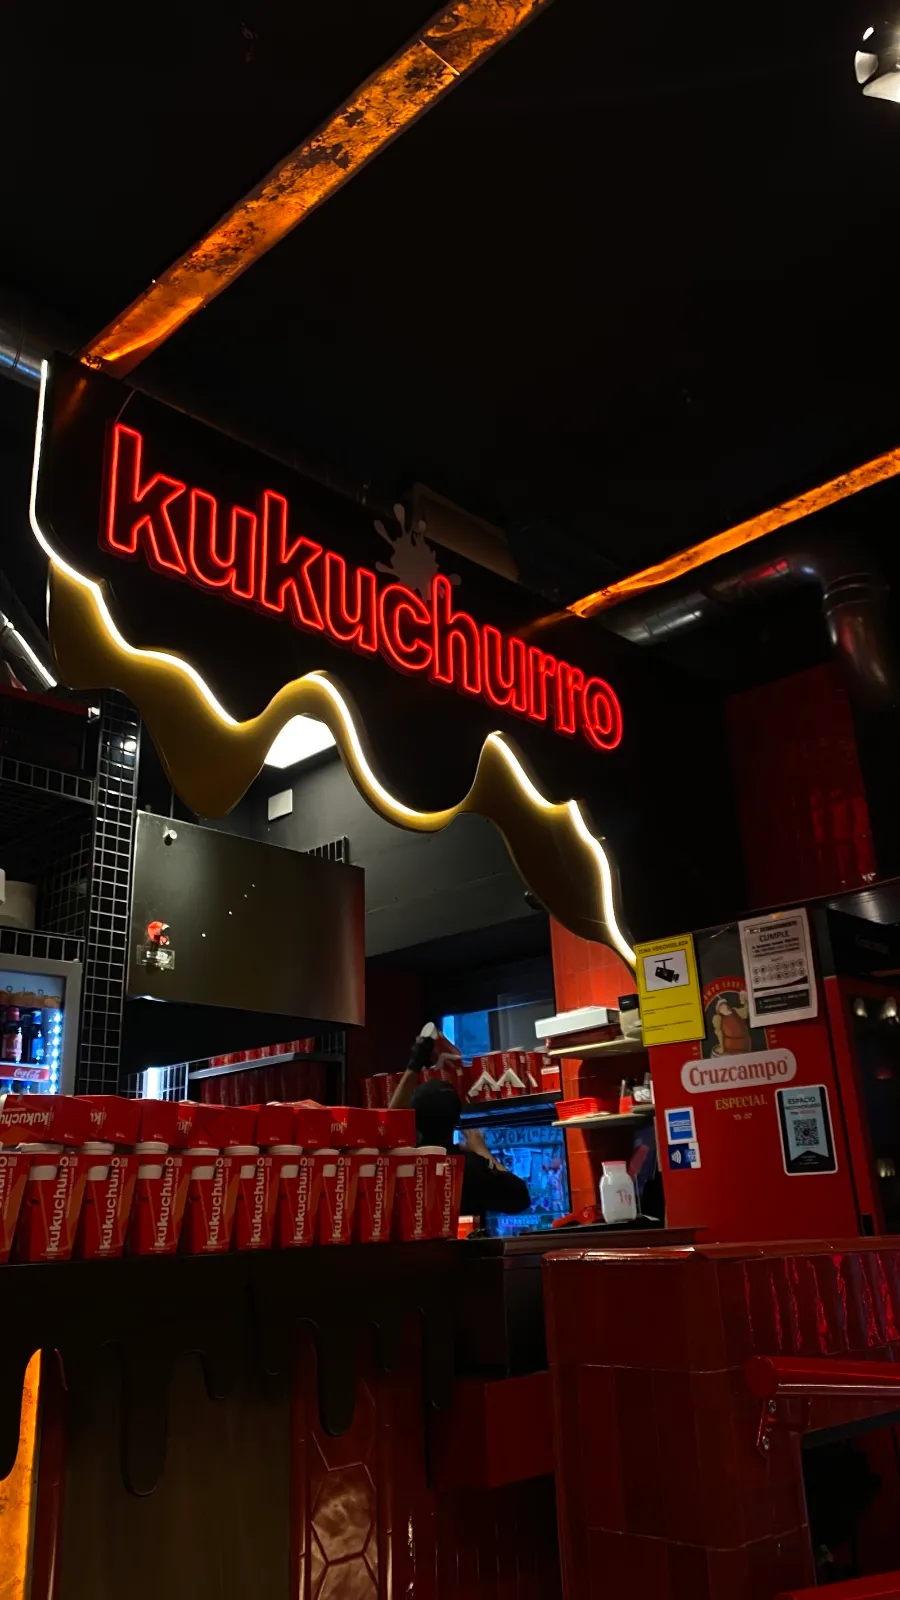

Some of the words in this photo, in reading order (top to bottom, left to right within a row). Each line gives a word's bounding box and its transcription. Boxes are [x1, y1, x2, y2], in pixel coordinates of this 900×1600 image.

[107, 423, 624, 750] kukuchurro
[760, 930, 790, 942] CUMPLE
[689, 1059, 788, 1087] Cruzcampo
[715, 1094, 768, 1110] ESPECIAL
[787, 1096, 816, 1105] ESPACIO
